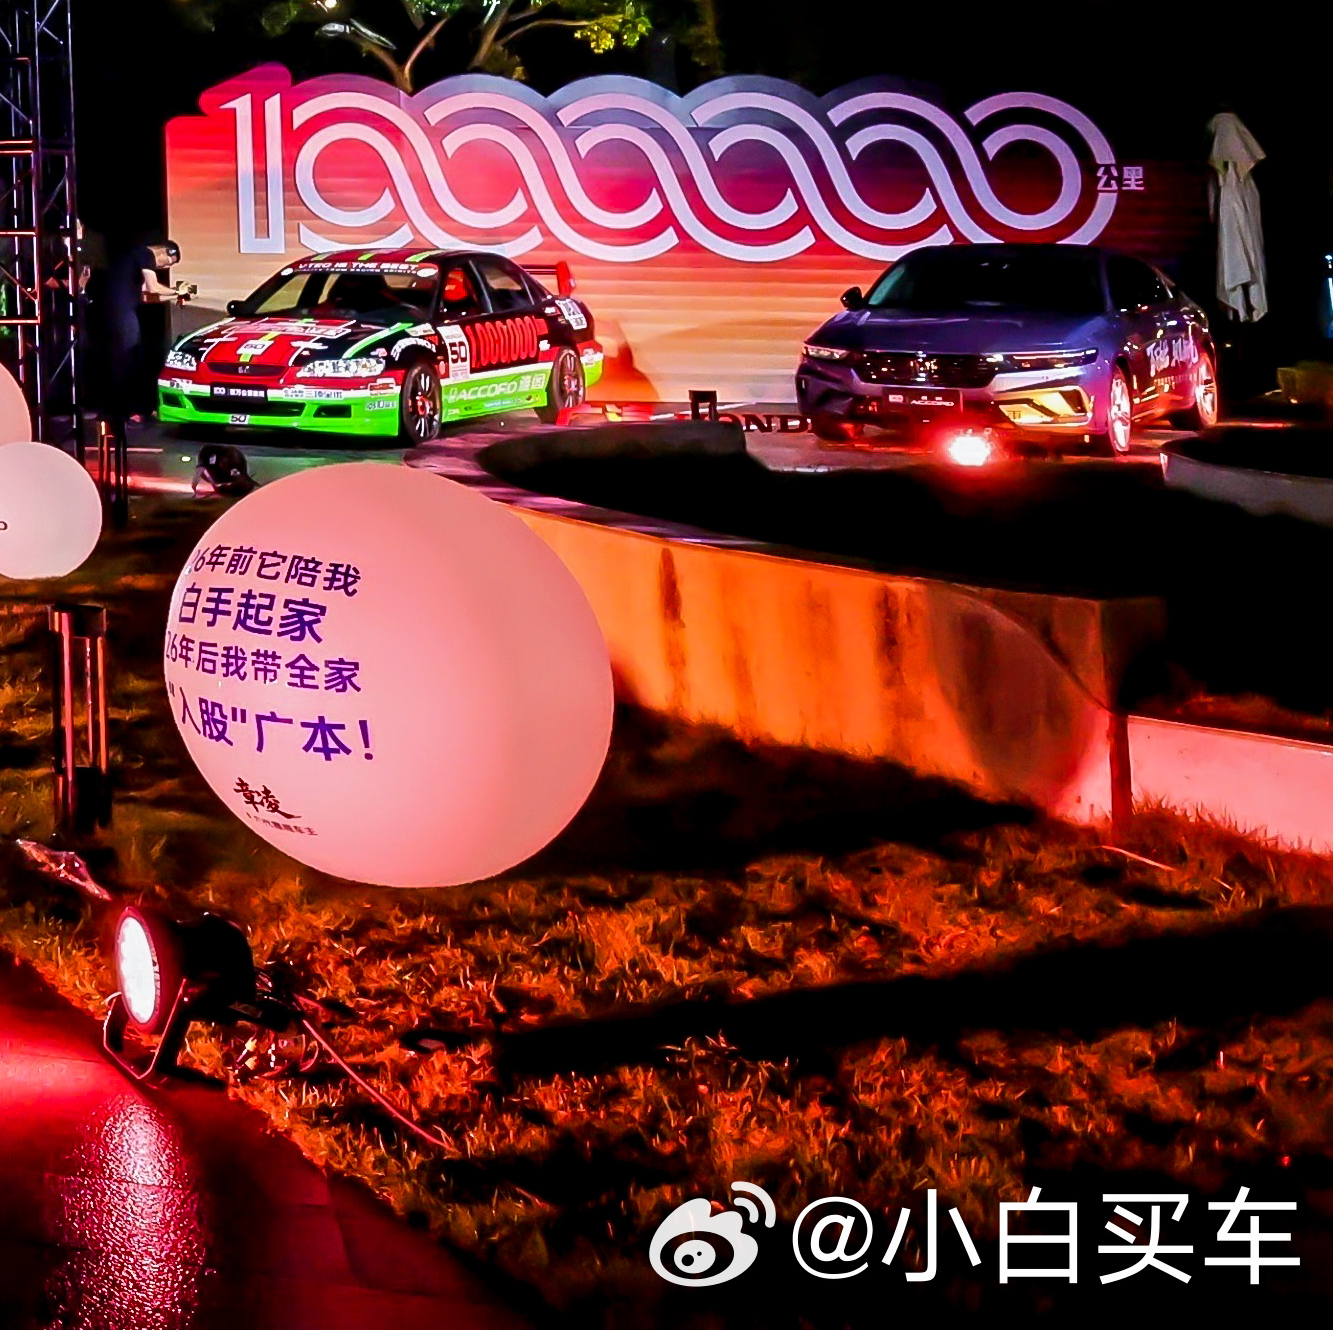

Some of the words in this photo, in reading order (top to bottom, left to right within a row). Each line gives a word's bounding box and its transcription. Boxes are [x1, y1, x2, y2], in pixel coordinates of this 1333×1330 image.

[1096, 166, 1145, 191] 公里
[449, 341, 467, 364] 50
[178, 582, 327, 644] 白手起家
